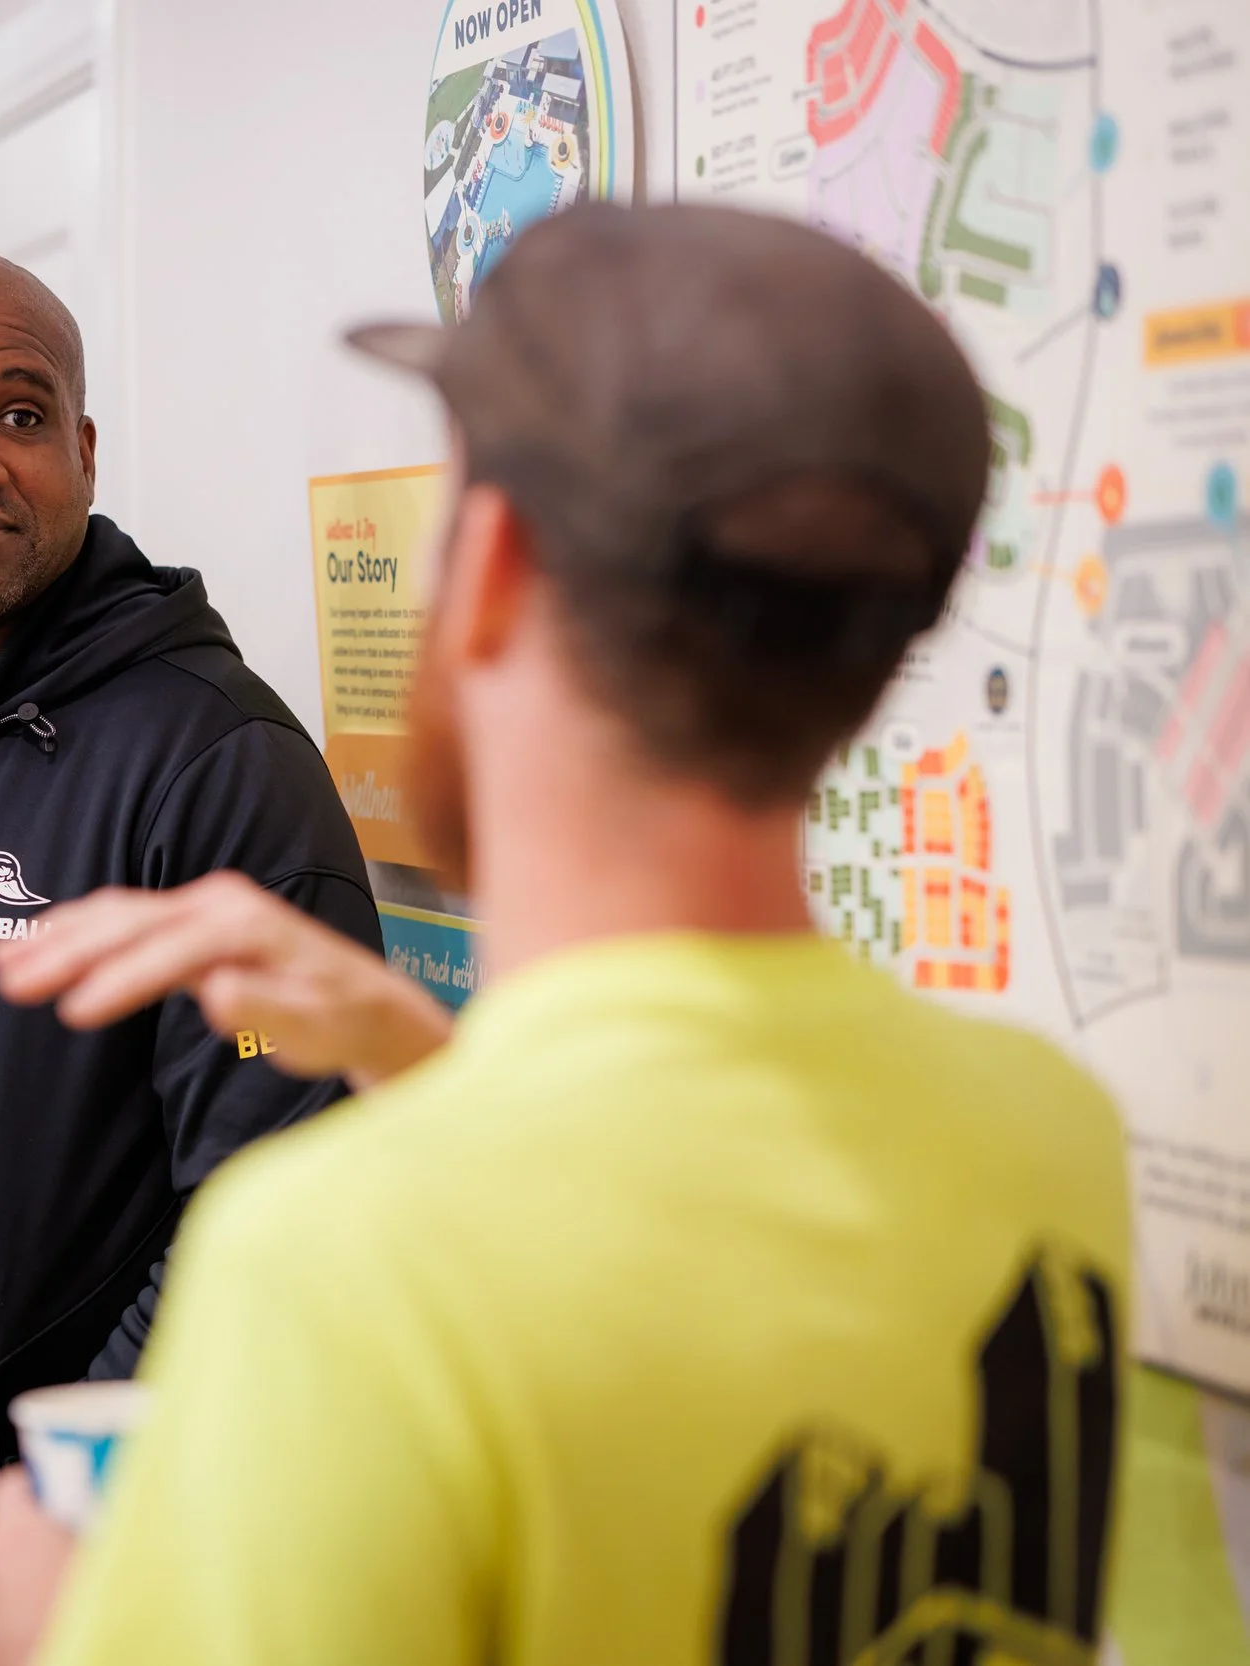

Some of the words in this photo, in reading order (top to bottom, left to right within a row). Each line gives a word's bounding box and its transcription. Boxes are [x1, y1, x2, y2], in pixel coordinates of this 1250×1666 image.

[455, 7, 491, 49] NOW
[496, 0, 541, 32] OPEN
[327, 552, 354, 583] Our
[357, 550, 397, 592] Story
[423, 951, 450, 985] Touch
[452, 956, 475, 992] with
